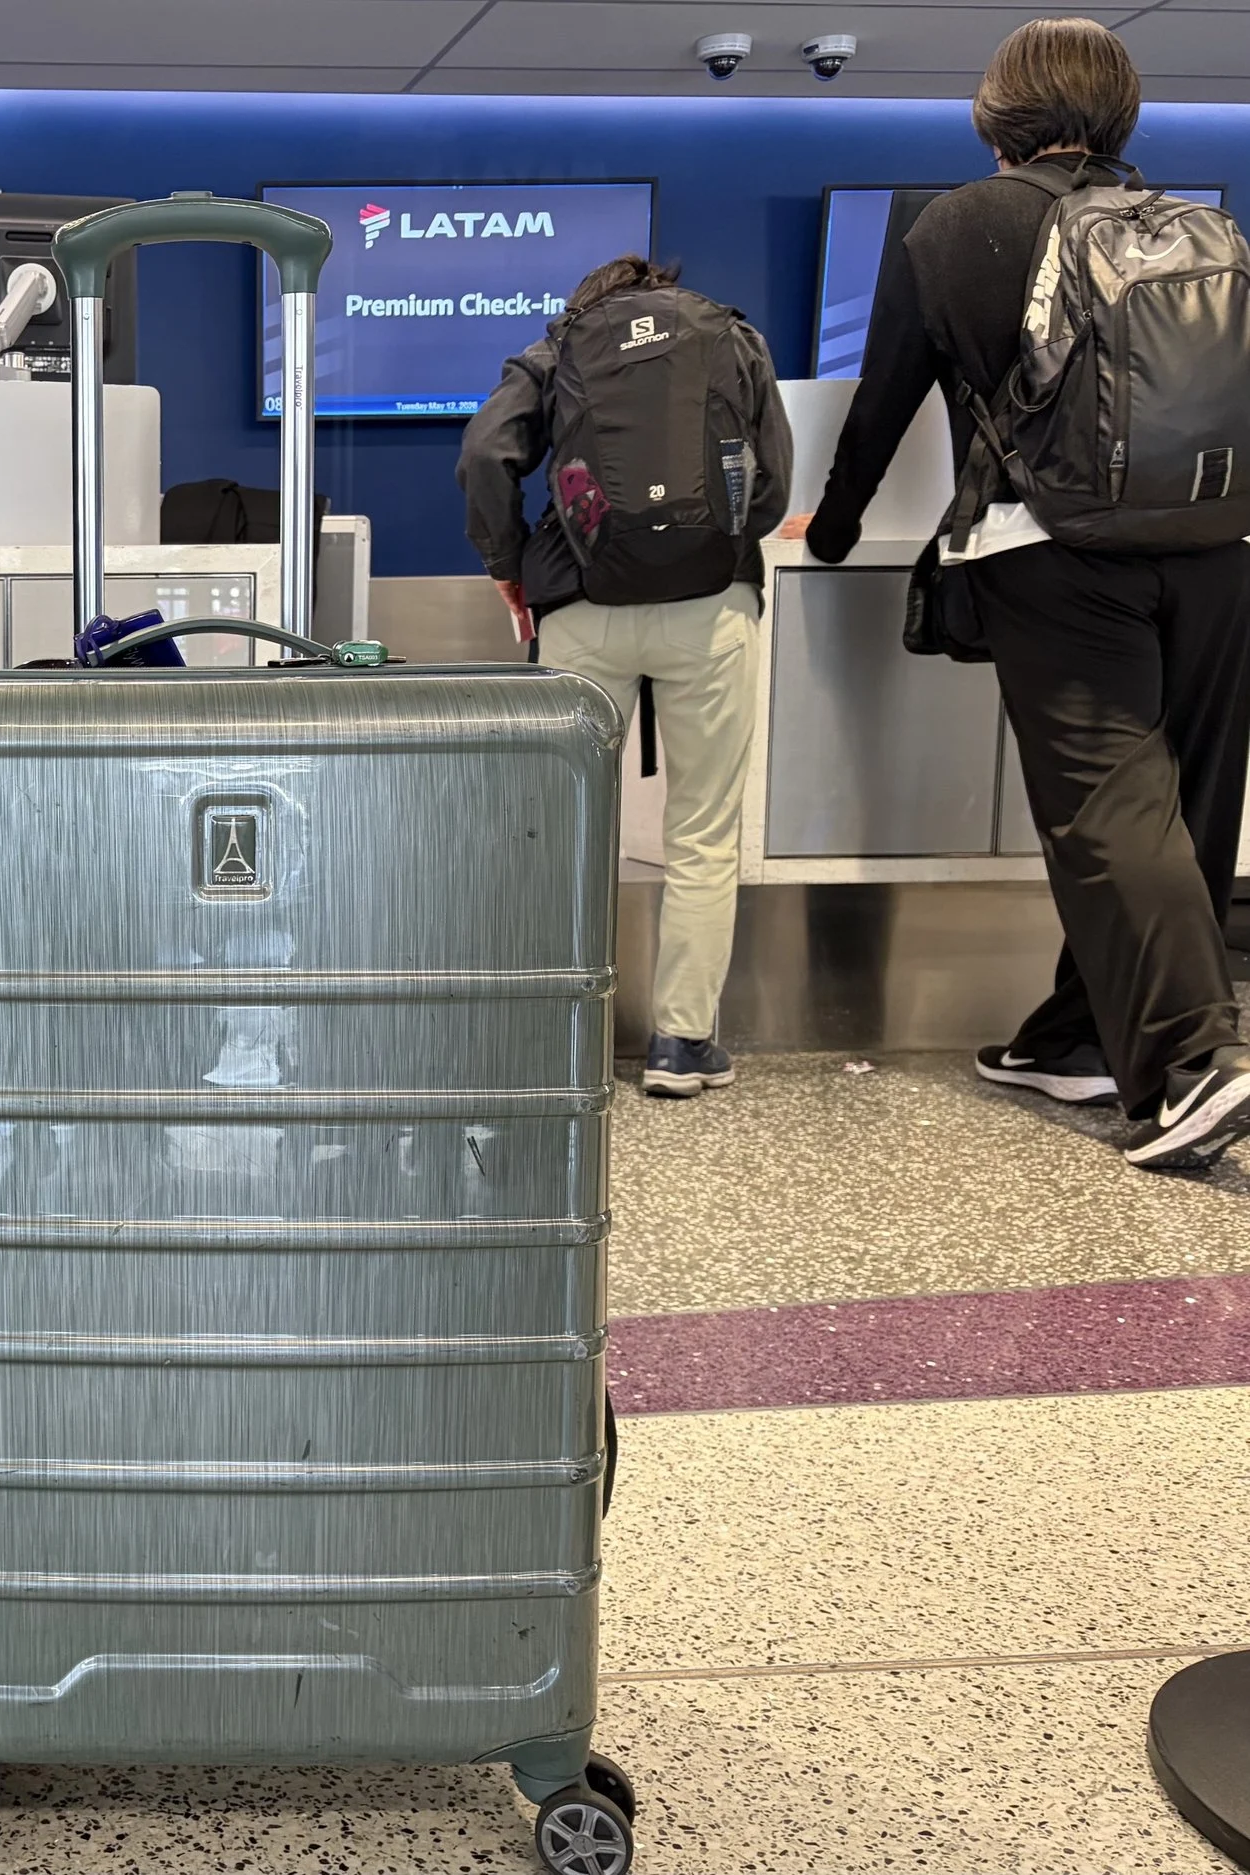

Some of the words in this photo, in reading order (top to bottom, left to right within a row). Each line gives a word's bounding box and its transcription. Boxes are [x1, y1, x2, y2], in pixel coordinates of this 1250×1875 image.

[400, 211, 555, 239] LATAM
[346, 293, 454, 318] Premium
[459, 291, 567, 316] Check-in
[649, 484, 665, 499] 20
